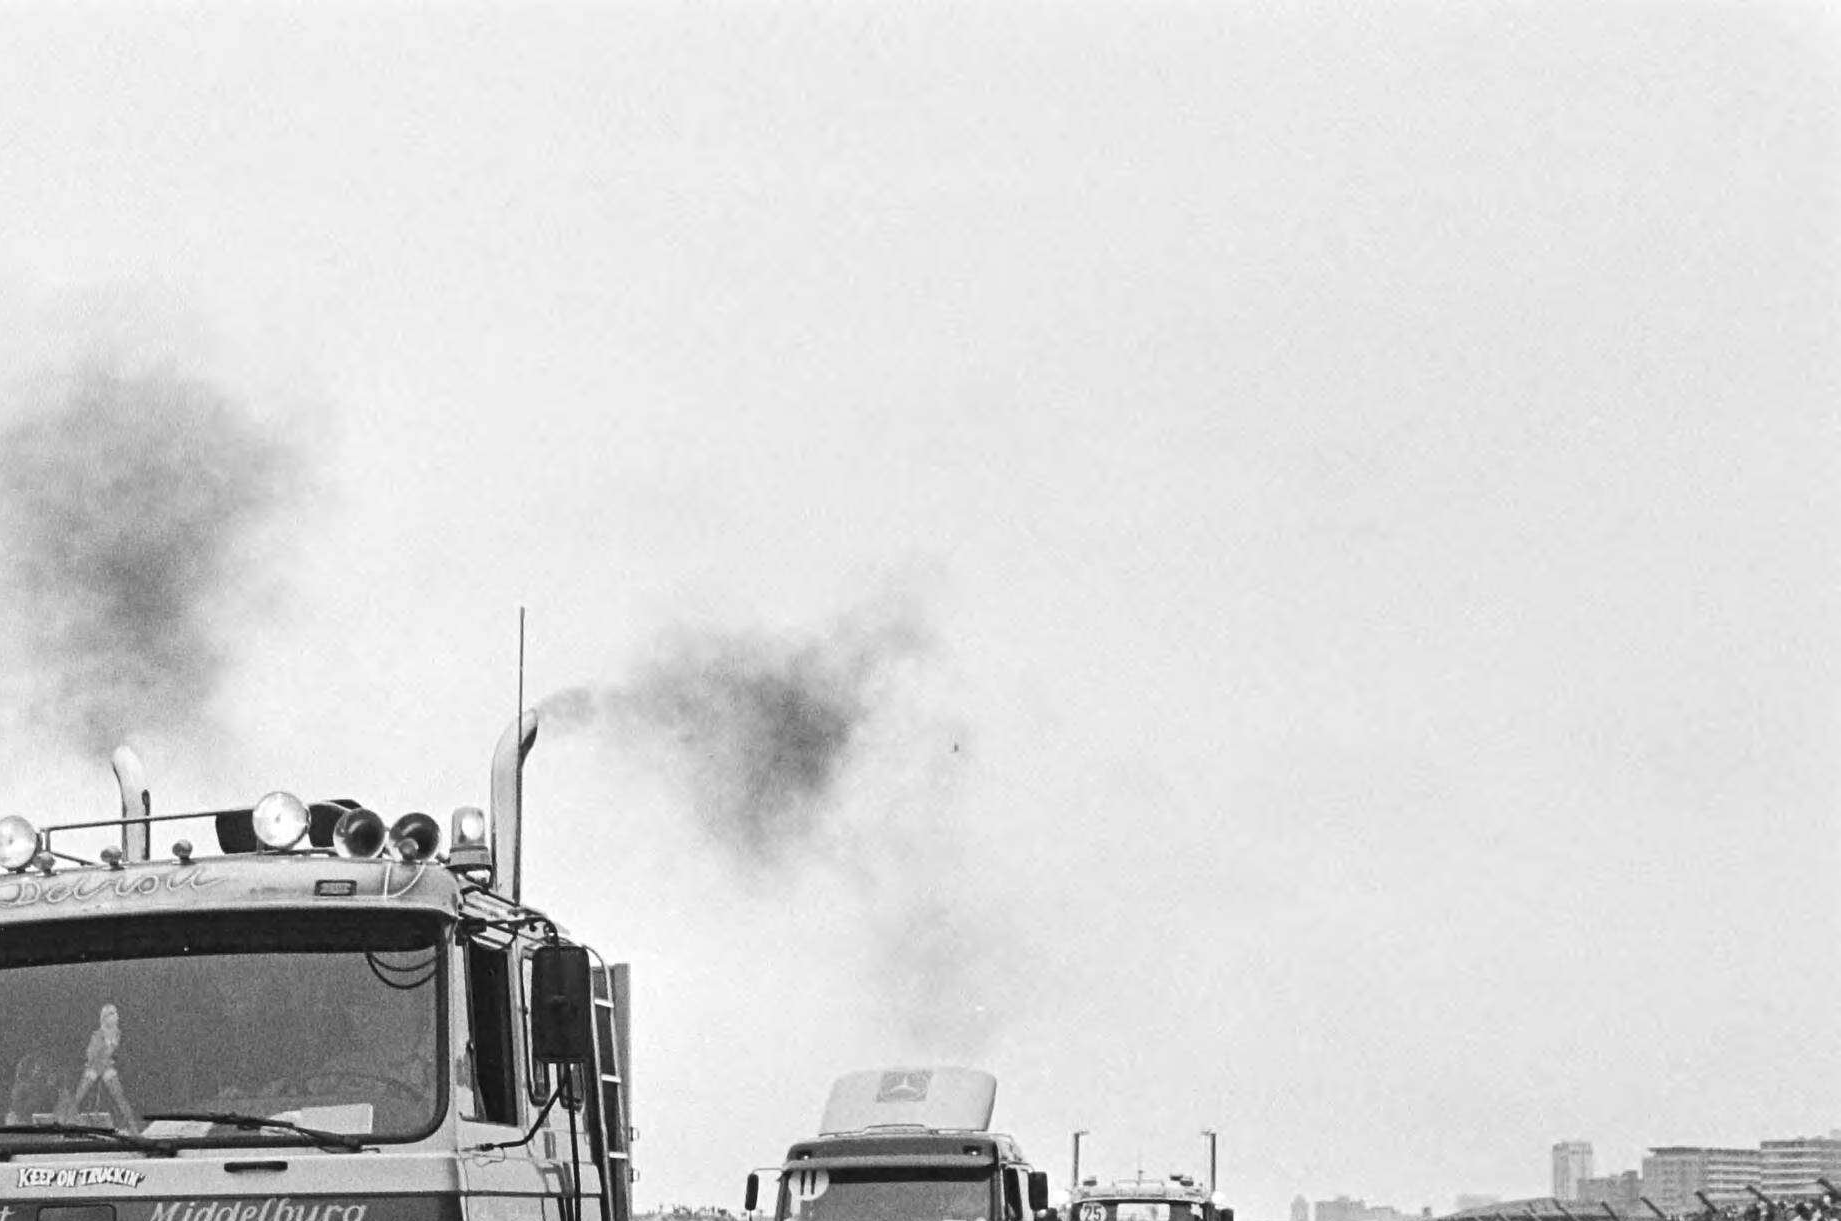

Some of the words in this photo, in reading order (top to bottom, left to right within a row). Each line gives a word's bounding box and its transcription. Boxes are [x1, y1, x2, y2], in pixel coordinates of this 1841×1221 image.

[18, 1167, 55, 1188] KEEP
[56, 1169, 78, 1188] ON
[79, 1166, 146, 1188] TRUCKIN'
[1083, 1205, 1102, 1221] 25
